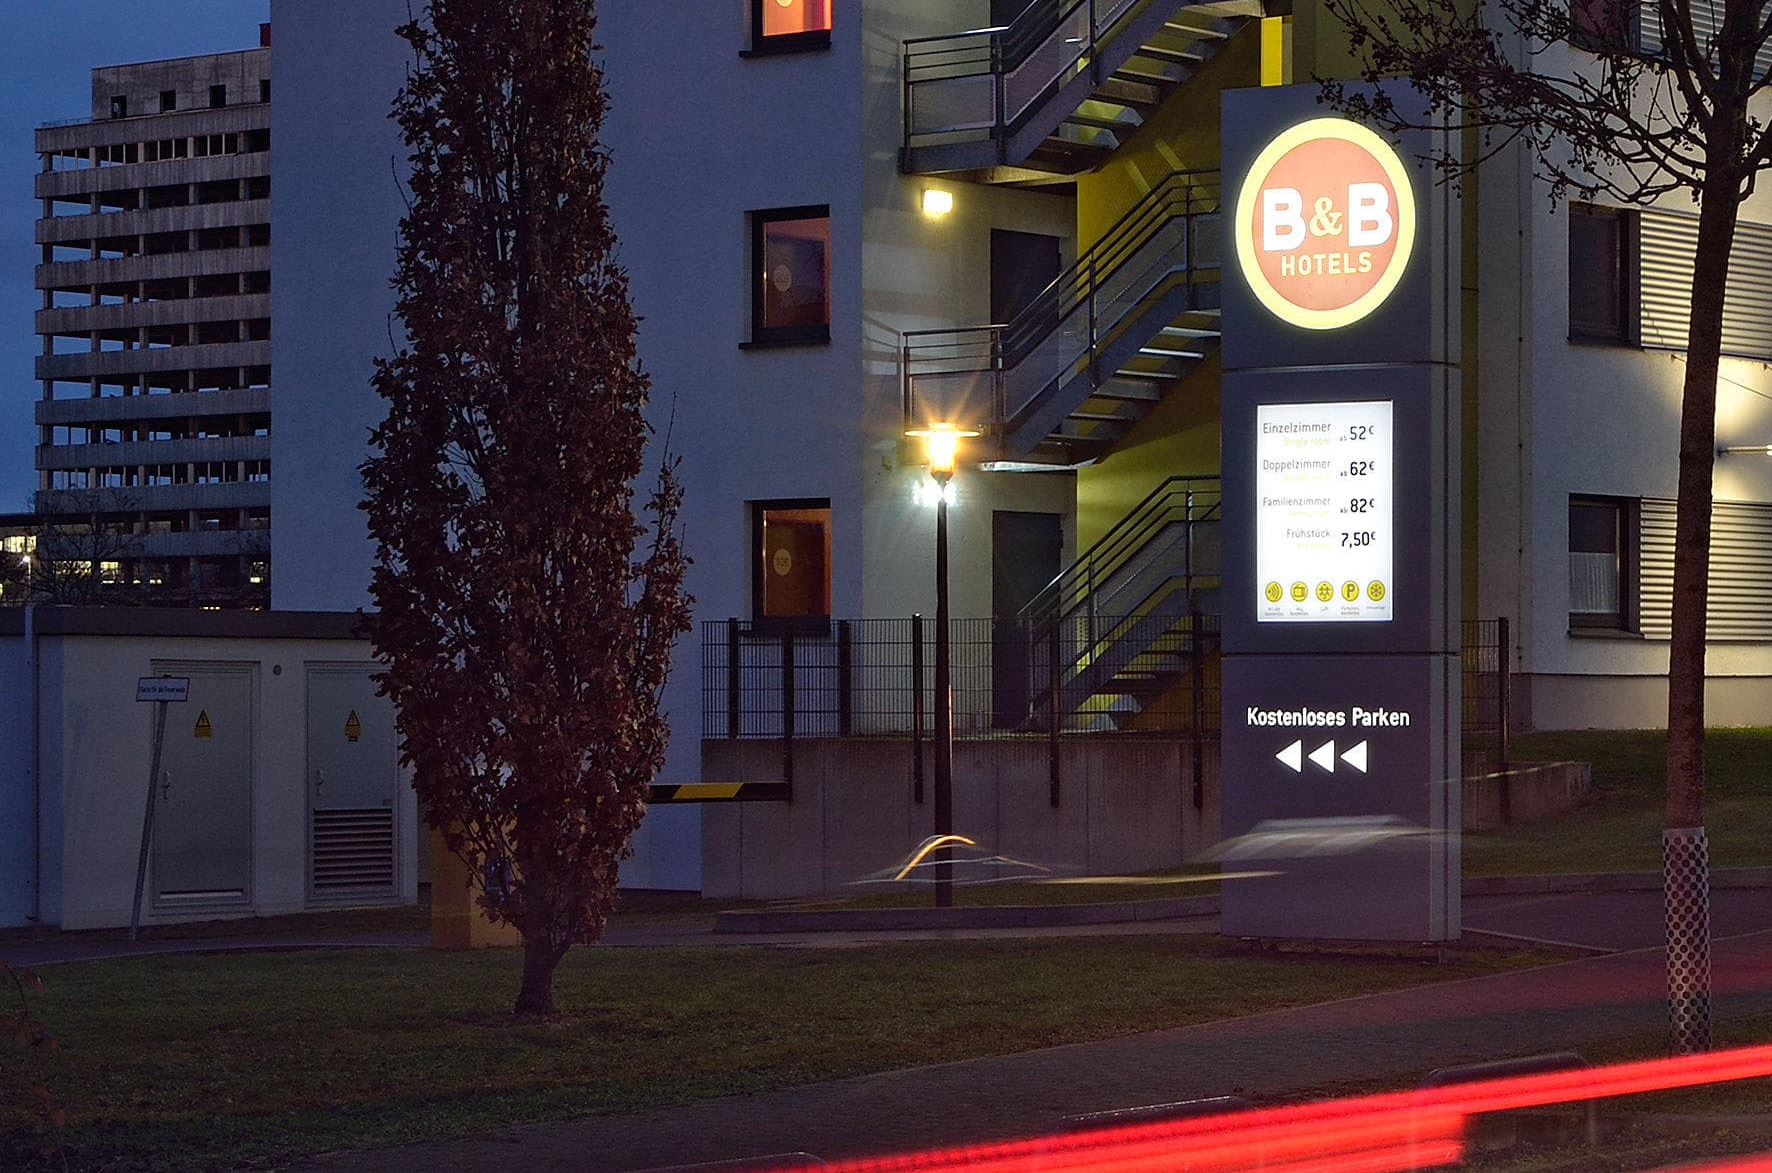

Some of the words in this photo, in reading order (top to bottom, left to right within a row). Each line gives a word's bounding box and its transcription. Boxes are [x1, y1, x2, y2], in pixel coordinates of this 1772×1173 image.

[1263, 182, 1393, 252] B&B
[1281, 251, 1373, 277] HOTELS
[1263, 423, 1331, 434] Einzelzimmer
[1263, 460, 1331, 472] Doppelzimmer
[1263, 497, 1331, 507] Familienzimmer
[1286, 528, 1331, 538] Frühstück
[1247, 707, 1346, 727] Kostenloses
[1352, 707, 1410, 727] Parken
